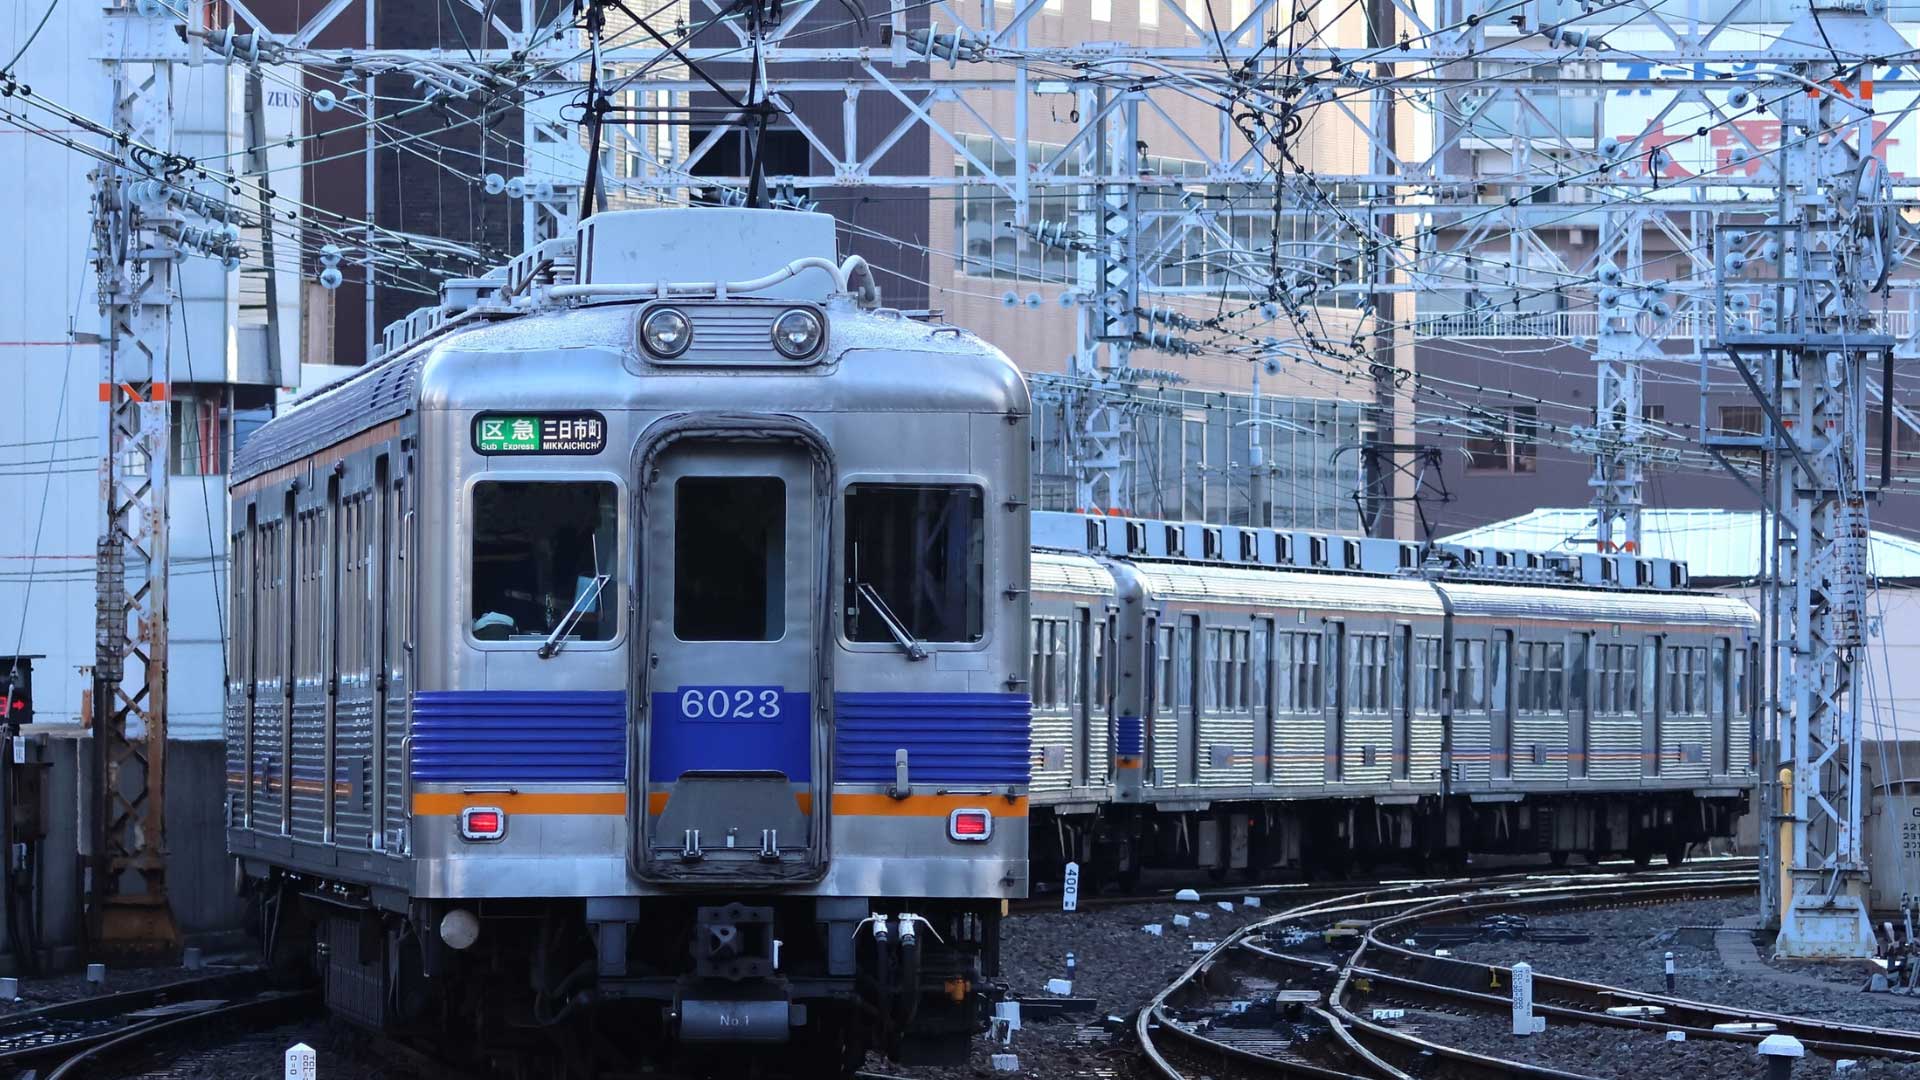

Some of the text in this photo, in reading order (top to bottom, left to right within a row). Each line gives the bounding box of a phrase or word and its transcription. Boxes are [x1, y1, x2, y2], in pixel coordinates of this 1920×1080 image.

[267, 91, 300, 108] ZEUS
[482, 419, 535, 441] 区急
[543, 418, 602, 441] 三日市町
[481, 442, 535, 450] Sub Express
[681, 689, 780, 718] 6023
